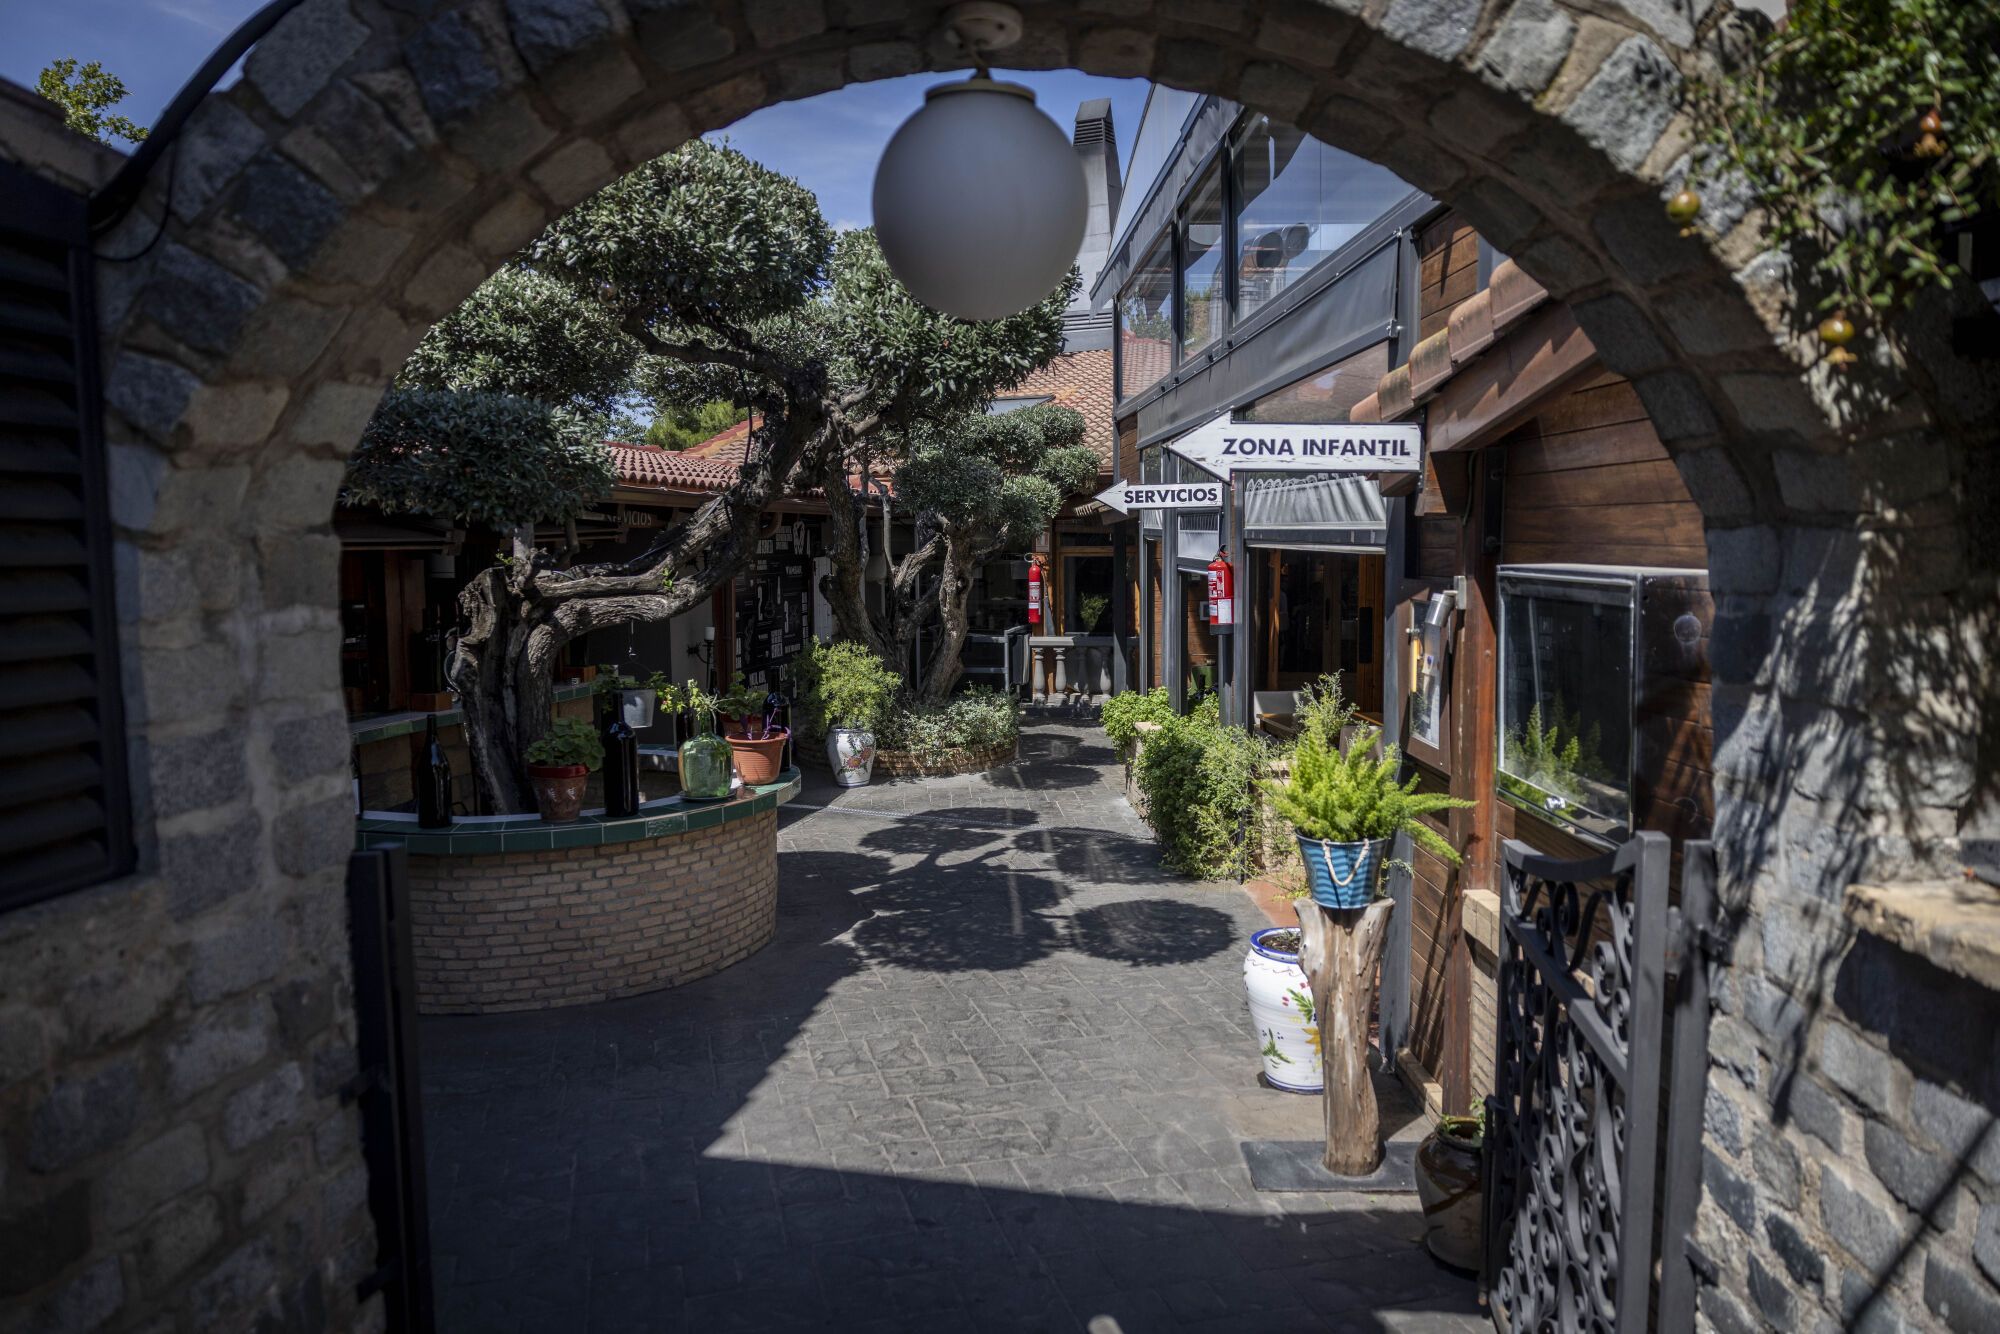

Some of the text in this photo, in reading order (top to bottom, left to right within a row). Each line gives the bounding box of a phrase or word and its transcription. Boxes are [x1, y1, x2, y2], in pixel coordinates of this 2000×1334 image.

[1222, 438, 1410, 456] ZONA INFANTIL
[1124, 488, 1217, 504] SERVICIOS
